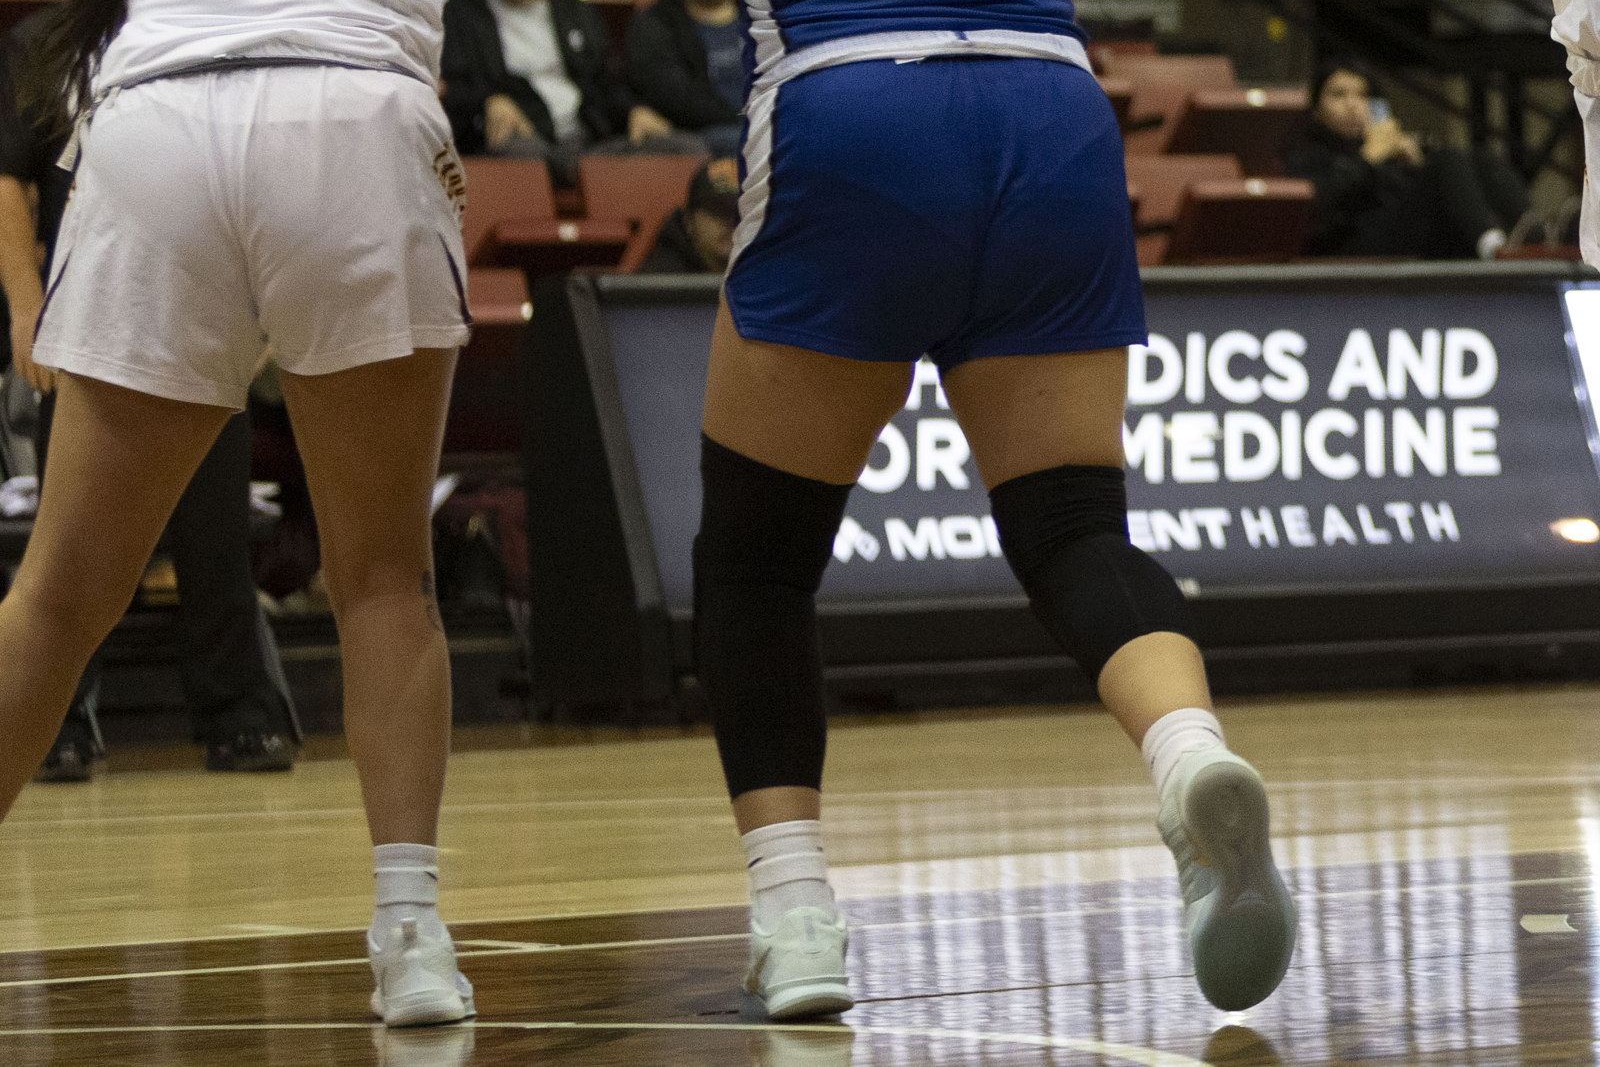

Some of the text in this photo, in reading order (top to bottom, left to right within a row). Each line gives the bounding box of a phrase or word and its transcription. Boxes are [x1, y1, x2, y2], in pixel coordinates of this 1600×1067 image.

[1327, 327, 1499, 402] AND
[1121, 406, 1502, 485] MEDICINE
[1239, 500, 1461, 550] HEALTH
